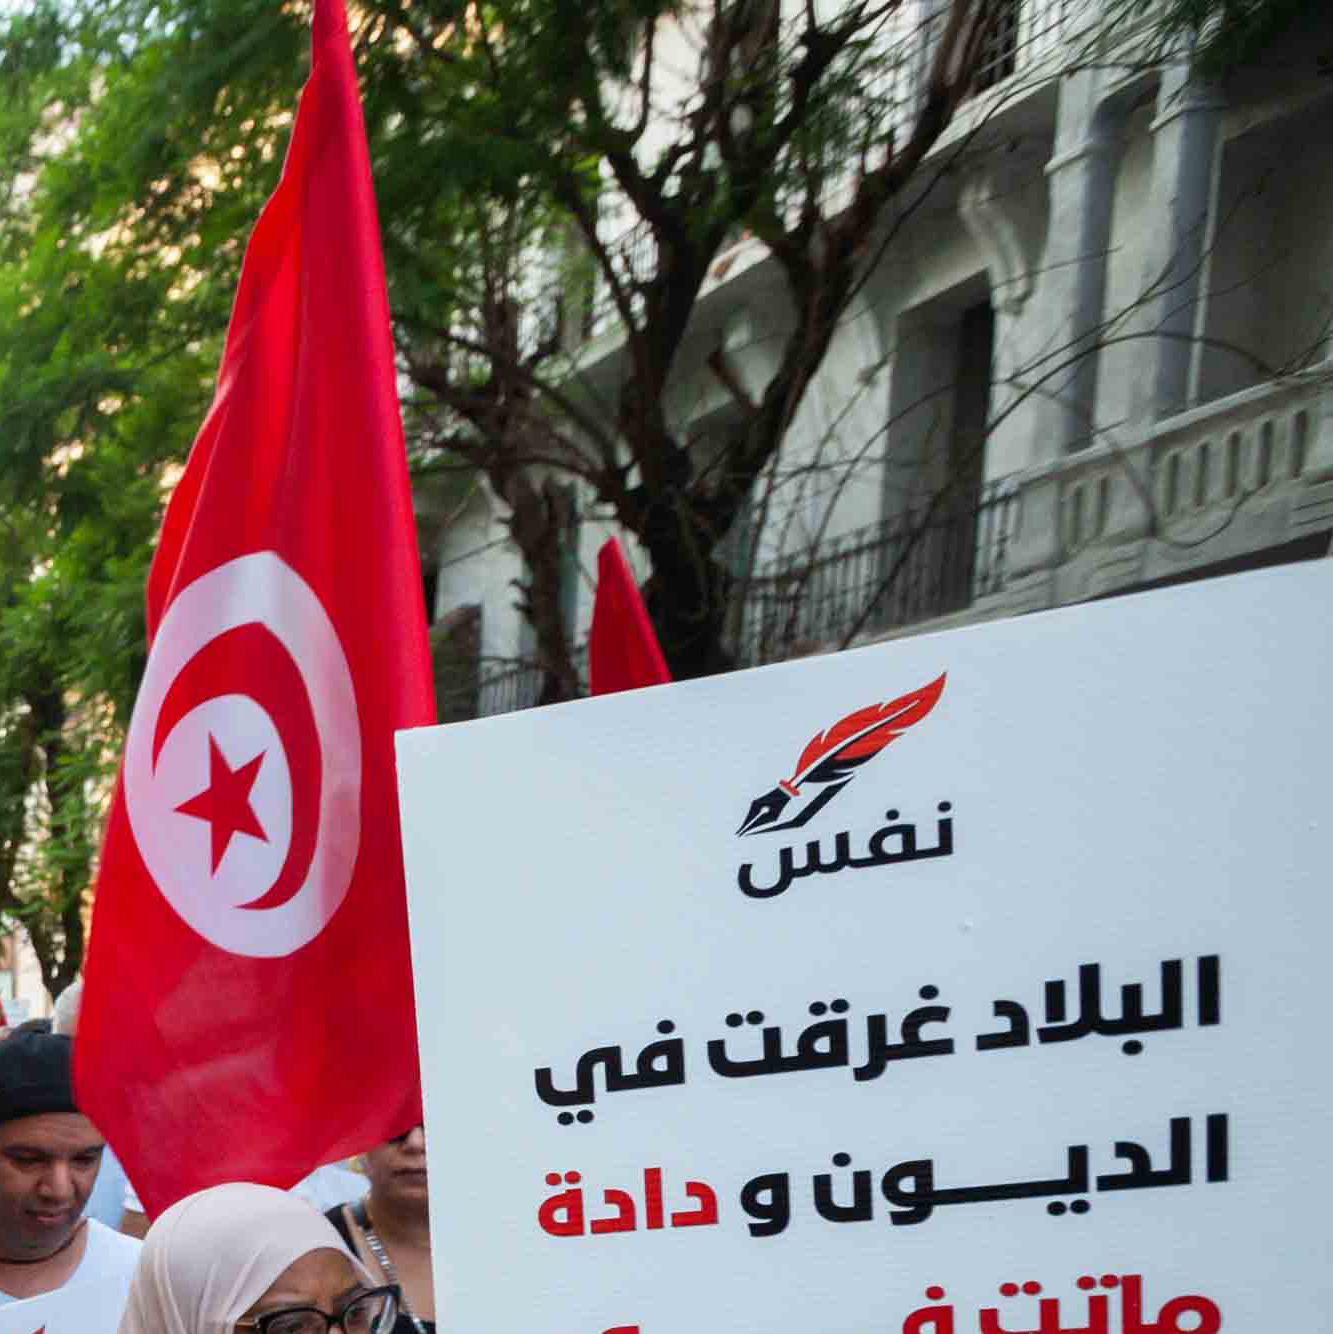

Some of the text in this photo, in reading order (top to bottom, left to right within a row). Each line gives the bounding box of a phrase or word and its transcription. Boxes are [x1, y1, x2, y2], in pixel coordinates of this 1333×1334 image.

[736, 800, 954, 899] نفس
[534, 953, 1222, 1127] البلاد غرقت في
[538, 1167, 720, 1238] دادة
[813, 1113, 1230, 1227] الديون
